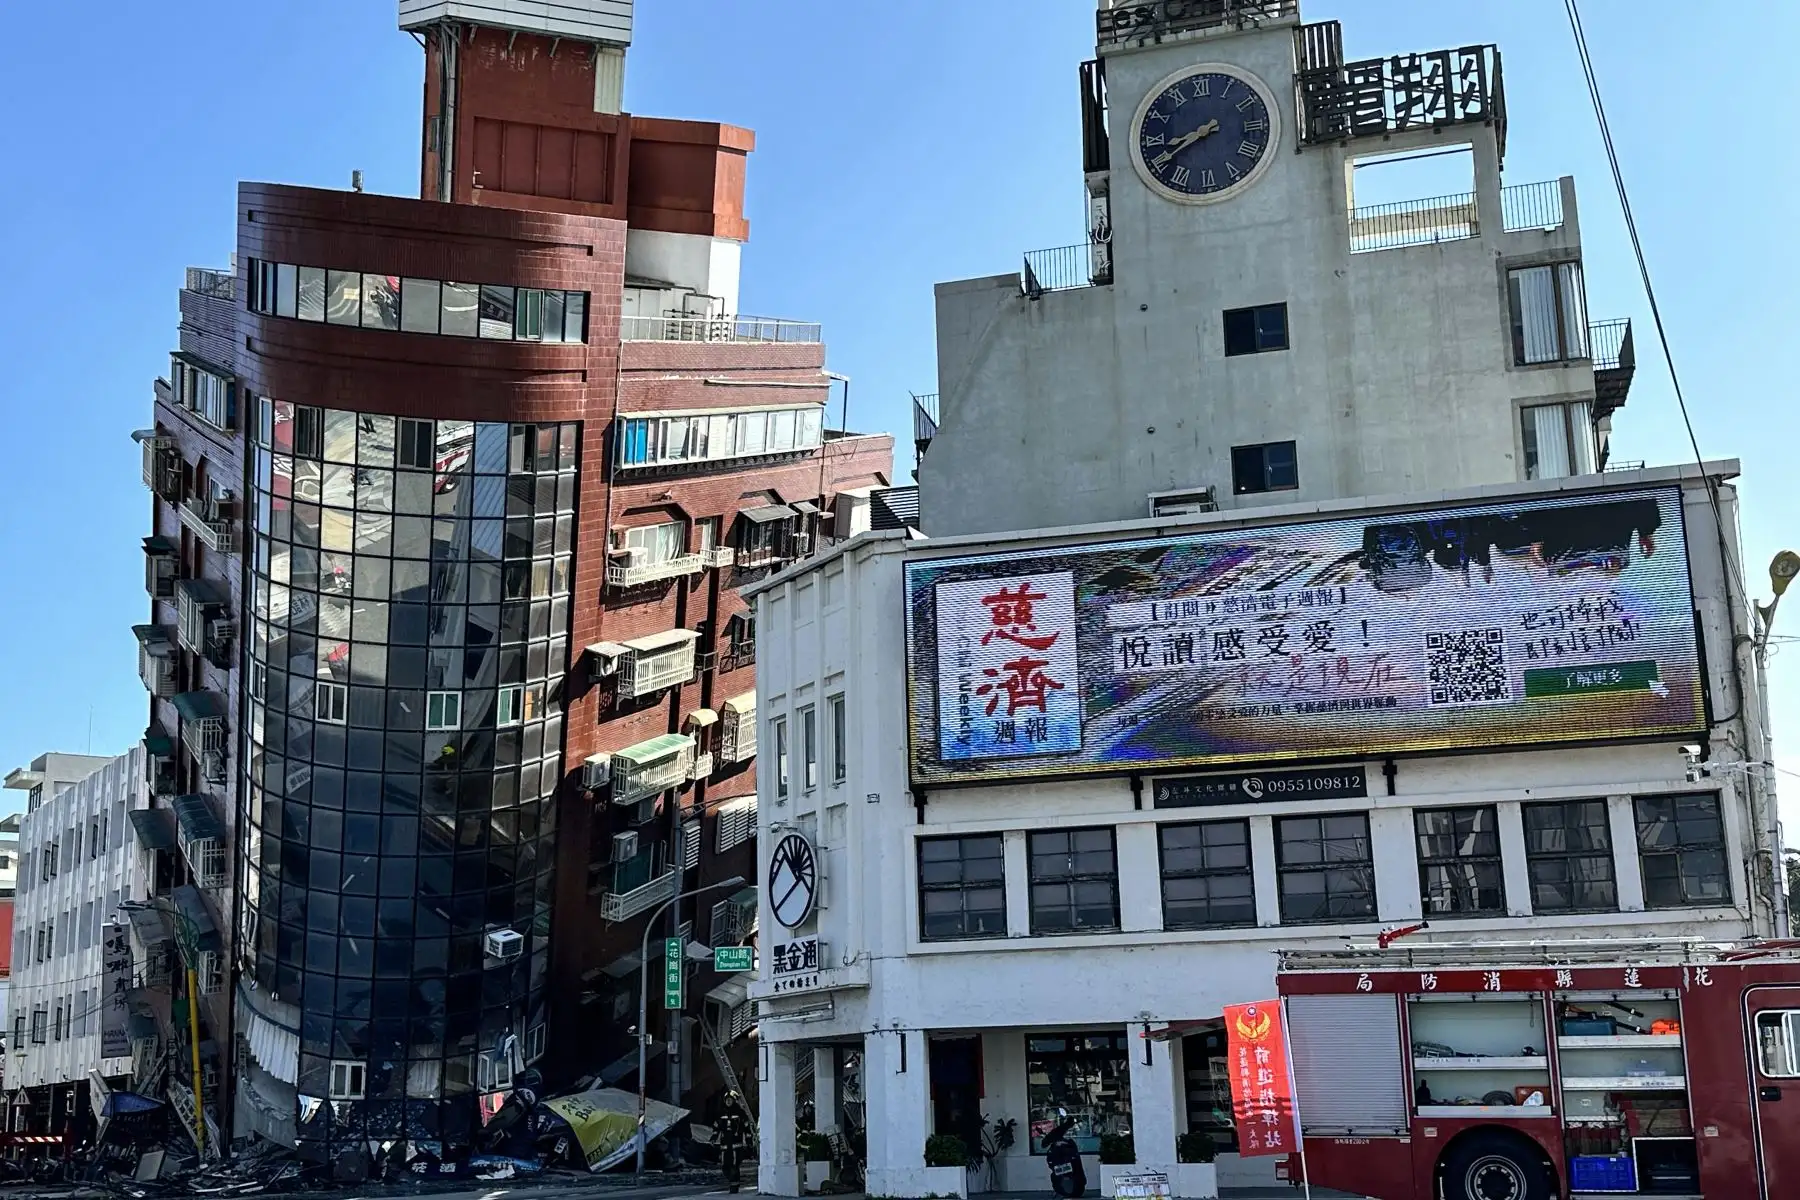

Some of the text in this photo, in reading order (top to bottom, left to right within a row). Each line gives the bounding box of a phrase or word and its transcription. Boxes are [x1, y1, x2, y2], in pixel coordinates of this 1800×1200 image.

[1193, 79, 1210, 97] XII
[1168, 88, 1188, 107] XI
[1235, 94, 1255, 112] II
[1244, 120, 1262, 132] III
[975, 582, 1065, 717] 慈濟
[956, 673, 974, 746] Weekly
[993, 716, 1049, 745] 週報
[1268, 775, 1361, 793] 0955109812
[720, 949, 747, 960] 中山路
[773, 939, 817, 974] 黑金通
